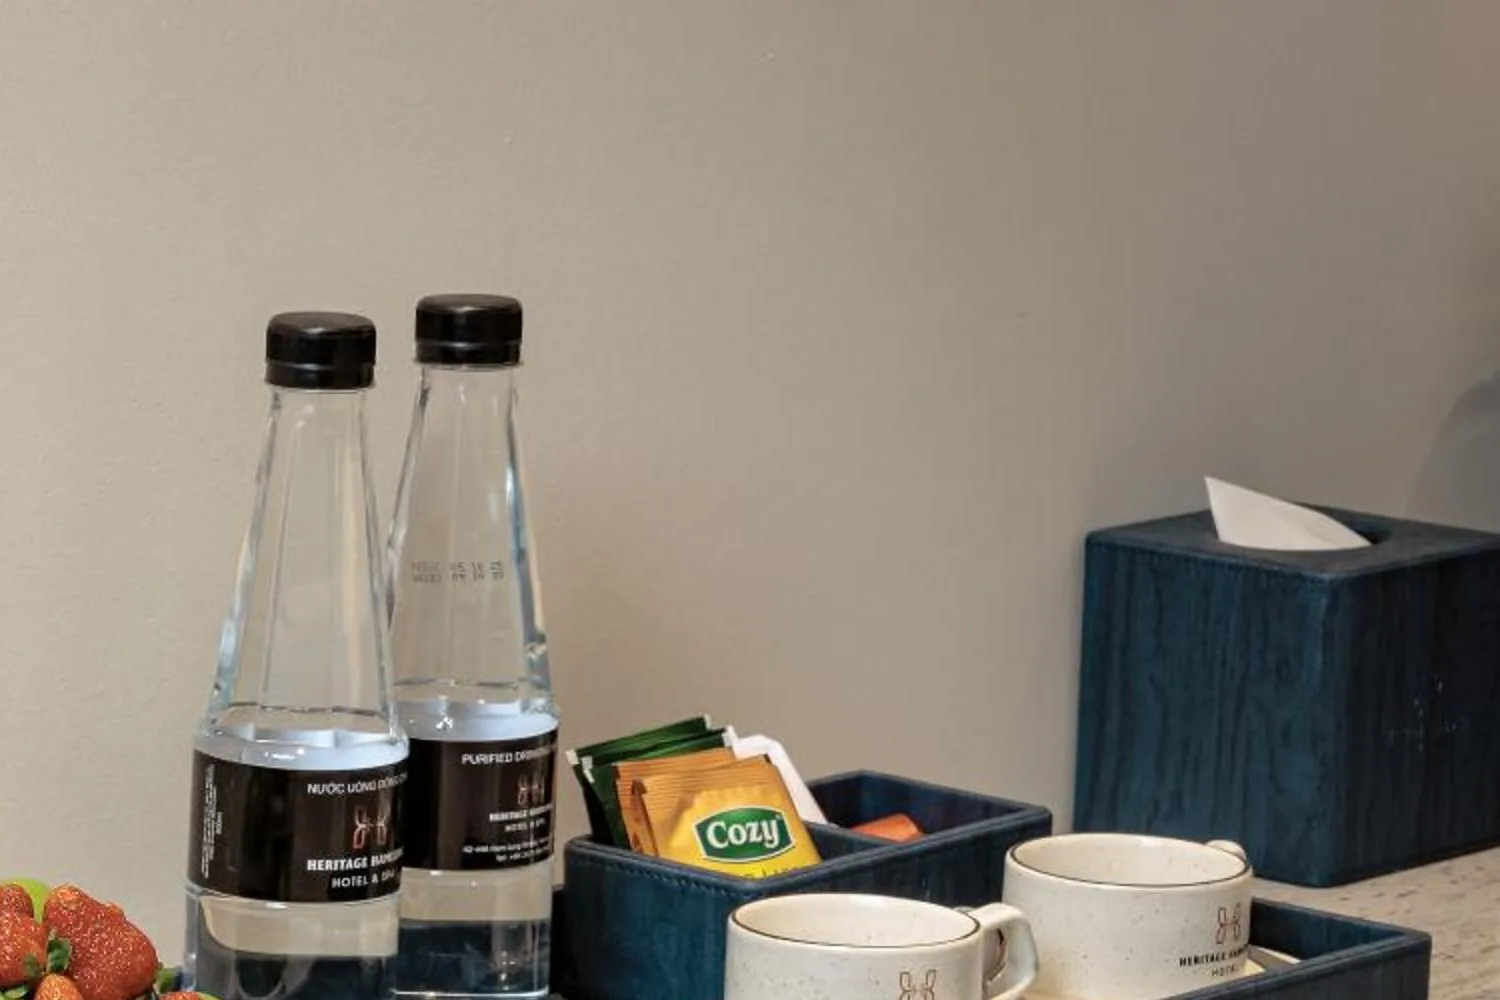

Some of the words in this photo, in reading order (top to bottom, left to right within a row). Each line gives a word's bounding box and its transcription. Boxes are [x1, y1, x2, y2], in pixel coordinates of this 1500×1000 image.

[461, 753, 513, 765] PURIFIED
[706, 818, 780, 849] Cozy
[307, 857, 368, 871] HERITAGE
[332, 876, 369, 888] HOTEL
[1179, 951, 1226, 967] HERITAGE
